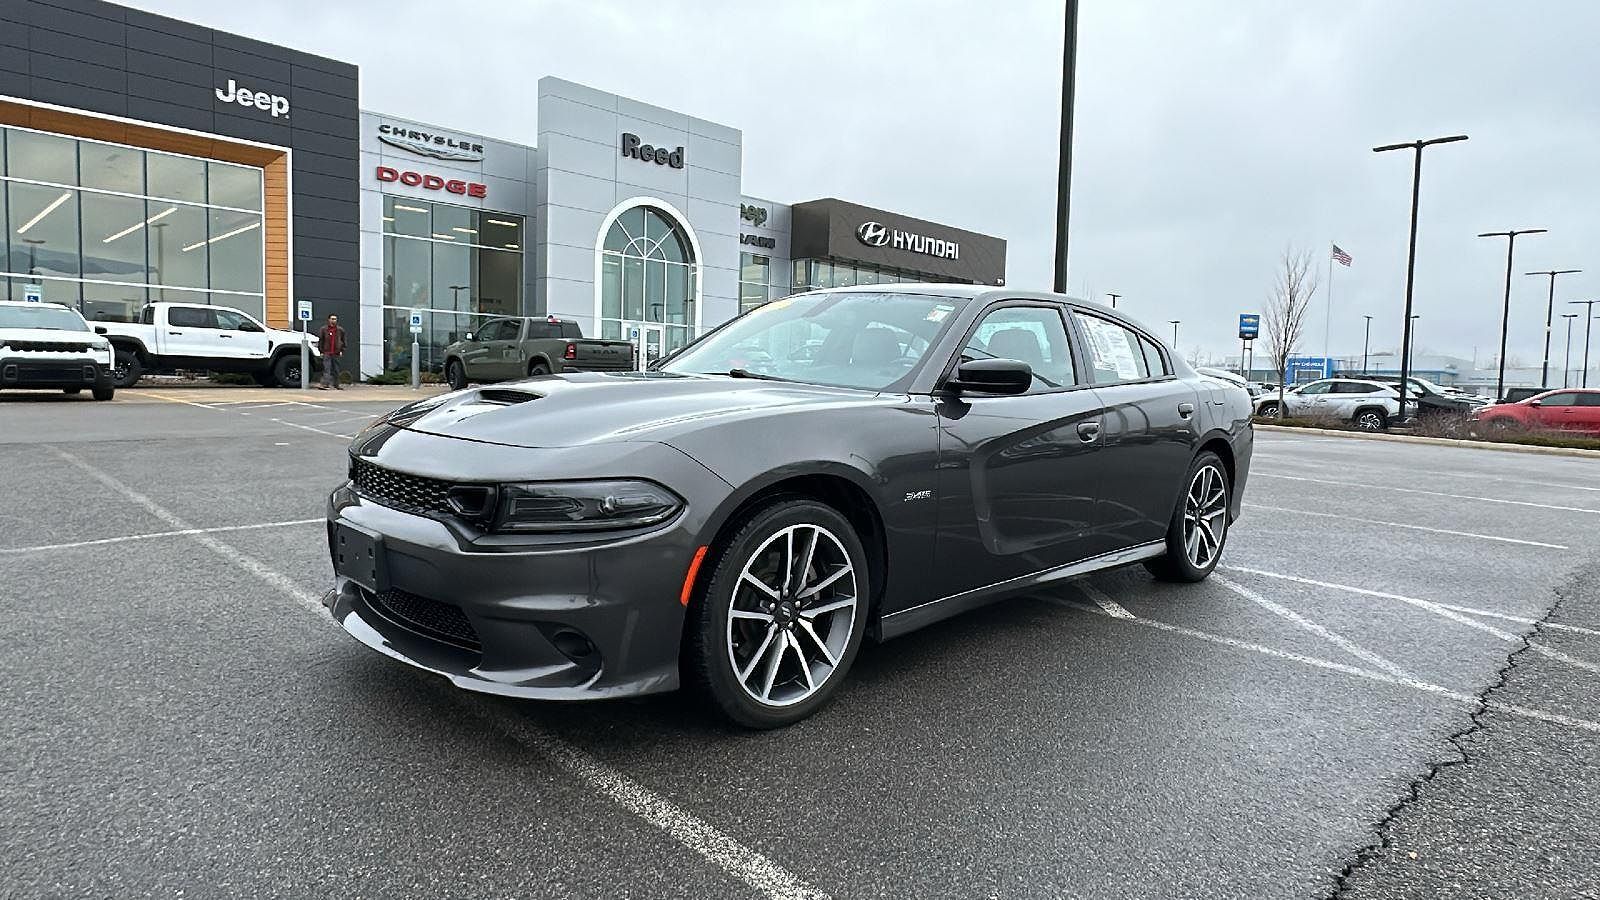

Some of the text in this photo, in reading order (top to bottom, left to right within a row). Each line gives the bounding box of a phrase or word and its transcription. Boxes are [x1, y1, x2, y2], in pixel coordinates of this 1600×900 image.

[215, 79, 290, 118] Jeep
[378, 124, 484, 153] CHRYSLER
[622, 132, 685, 169] Reed
[376, 166, 487, 199] DODGE
[893, 229, 959, 260] HYUNDAI
